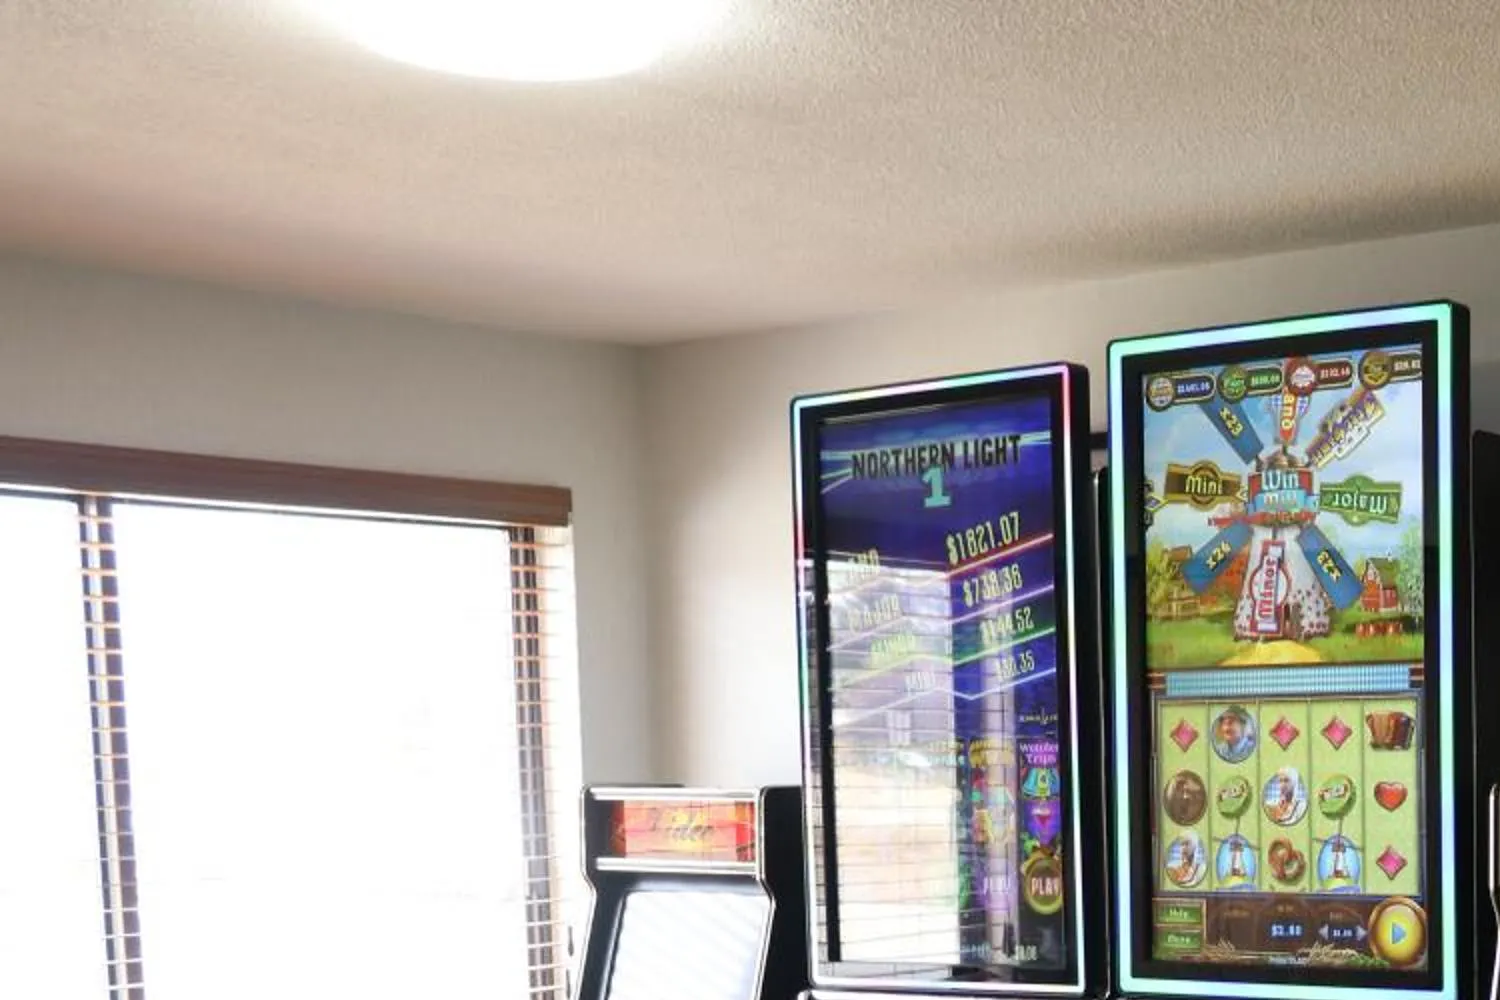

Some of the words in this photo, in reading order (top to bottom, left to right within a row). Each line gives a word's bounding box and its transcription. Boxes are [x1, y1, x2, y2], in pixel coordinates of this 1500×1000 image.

[852, 442, 954, 480] NORTHERN
[963, 434, 1021, 465] LIGHT
[922, 466, 951, 508] 1
[1185, 475, 1223, 495] Mini
[1331, 491, 1388, 515] Major
